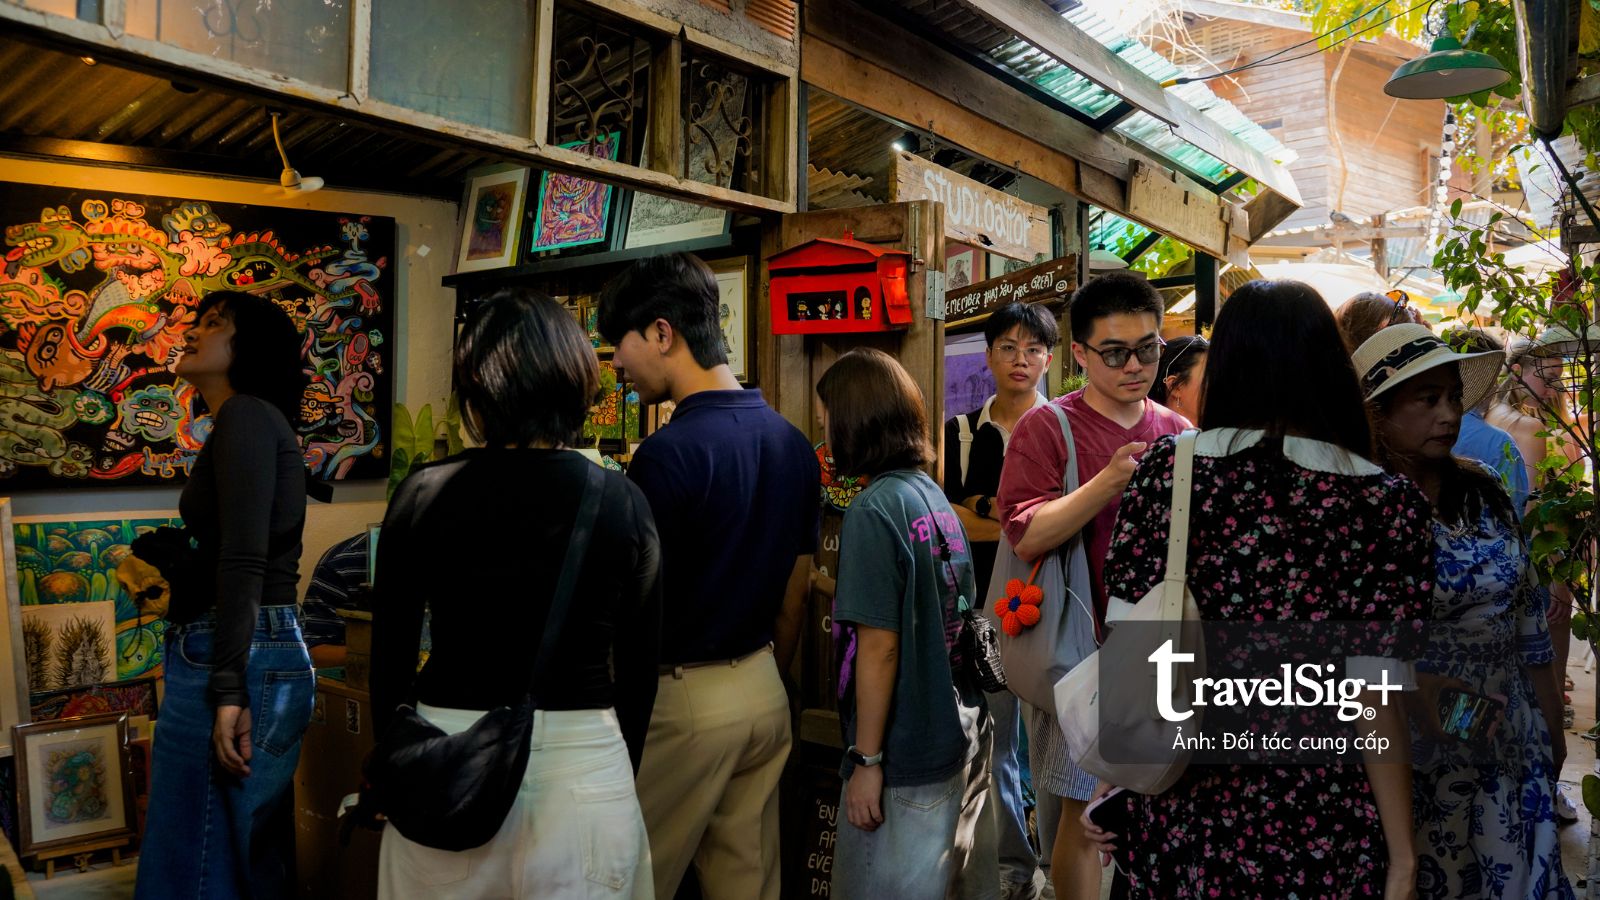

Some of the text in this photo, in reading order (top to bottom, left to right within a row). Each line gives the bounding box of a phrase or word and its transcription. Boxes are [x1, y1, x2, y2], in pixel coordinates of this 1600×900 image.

[255, 262, 266, 271] Hi
[945, 292, 981, 315] EMEMBER
[1013, 282, 1030, 301] ARE
